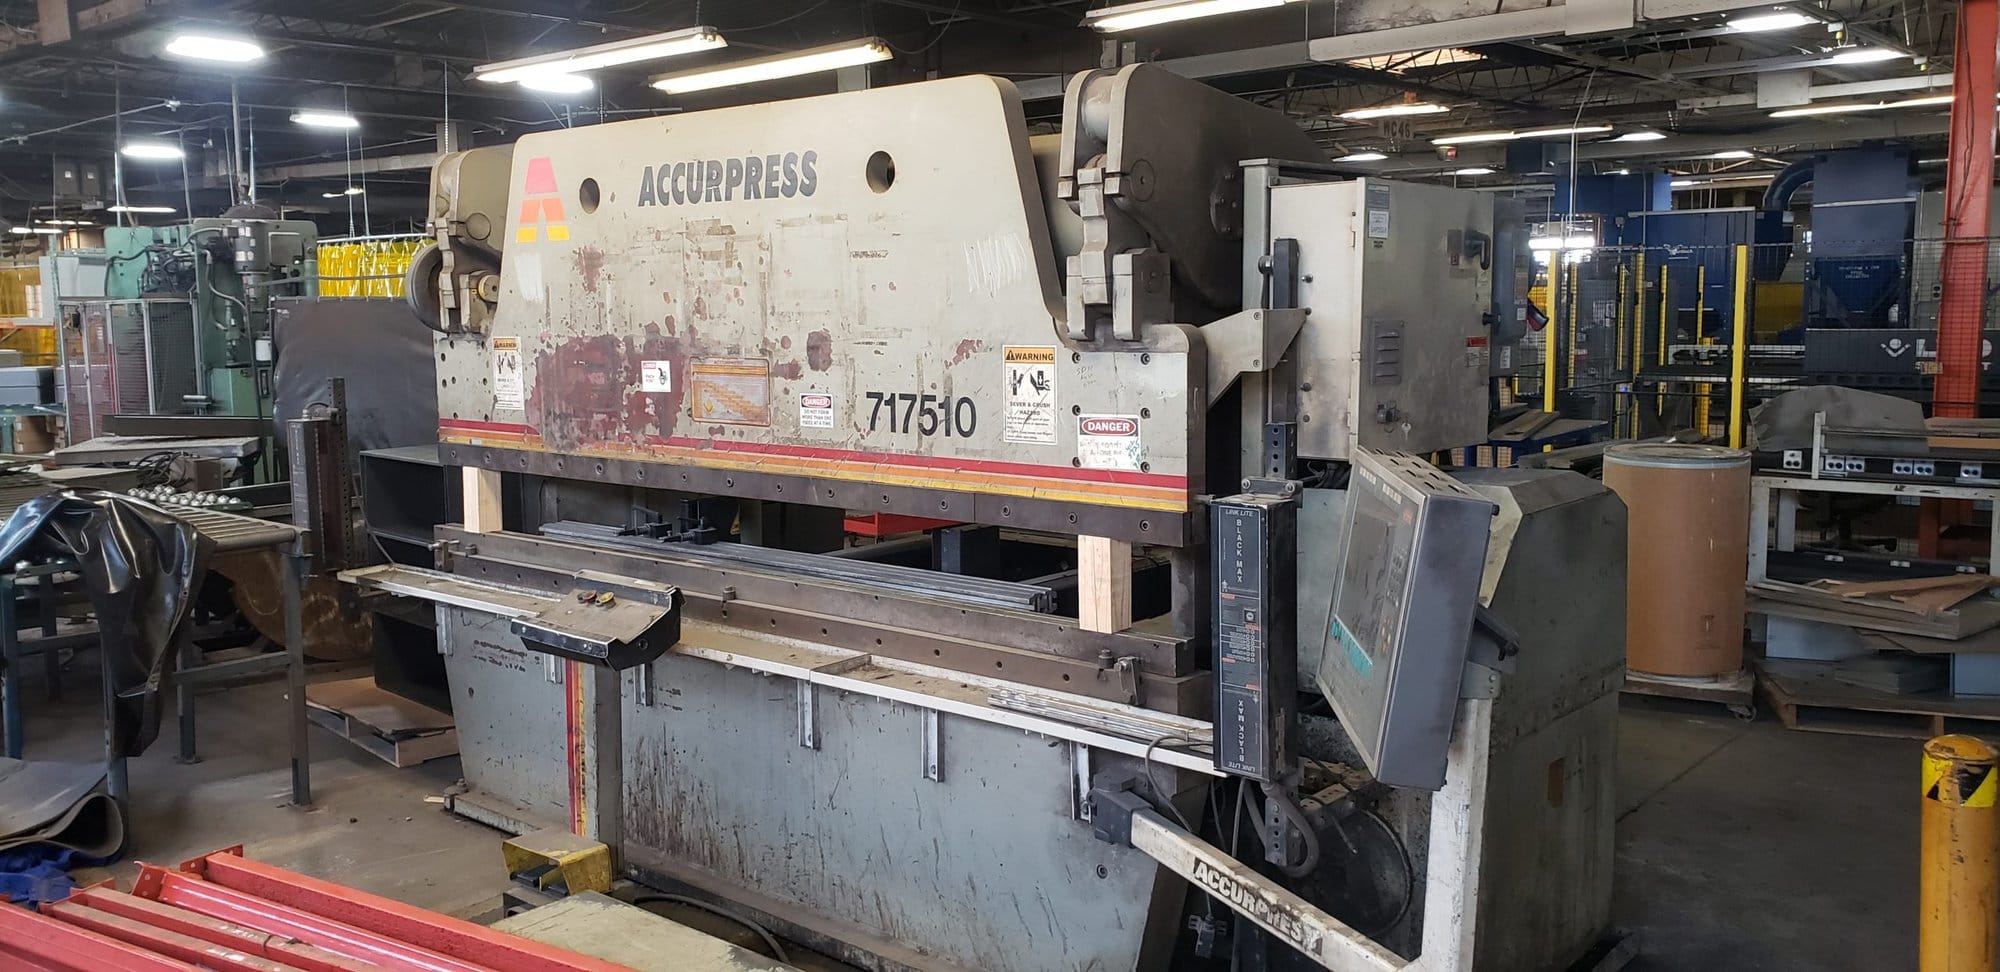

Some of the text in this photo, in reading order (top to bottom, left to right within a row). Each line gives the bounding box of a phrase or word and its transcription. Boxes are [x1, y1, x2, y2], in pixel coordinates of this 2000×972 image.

[637, 150, 818, 207] ACCURPRESS
[1014, 353, 1054, 361] WARNING
[865, 391, 977, 438] 717510
[1087, 421, 1131, 433] DANGER
[1225, 508, 1240, 516] LINK
